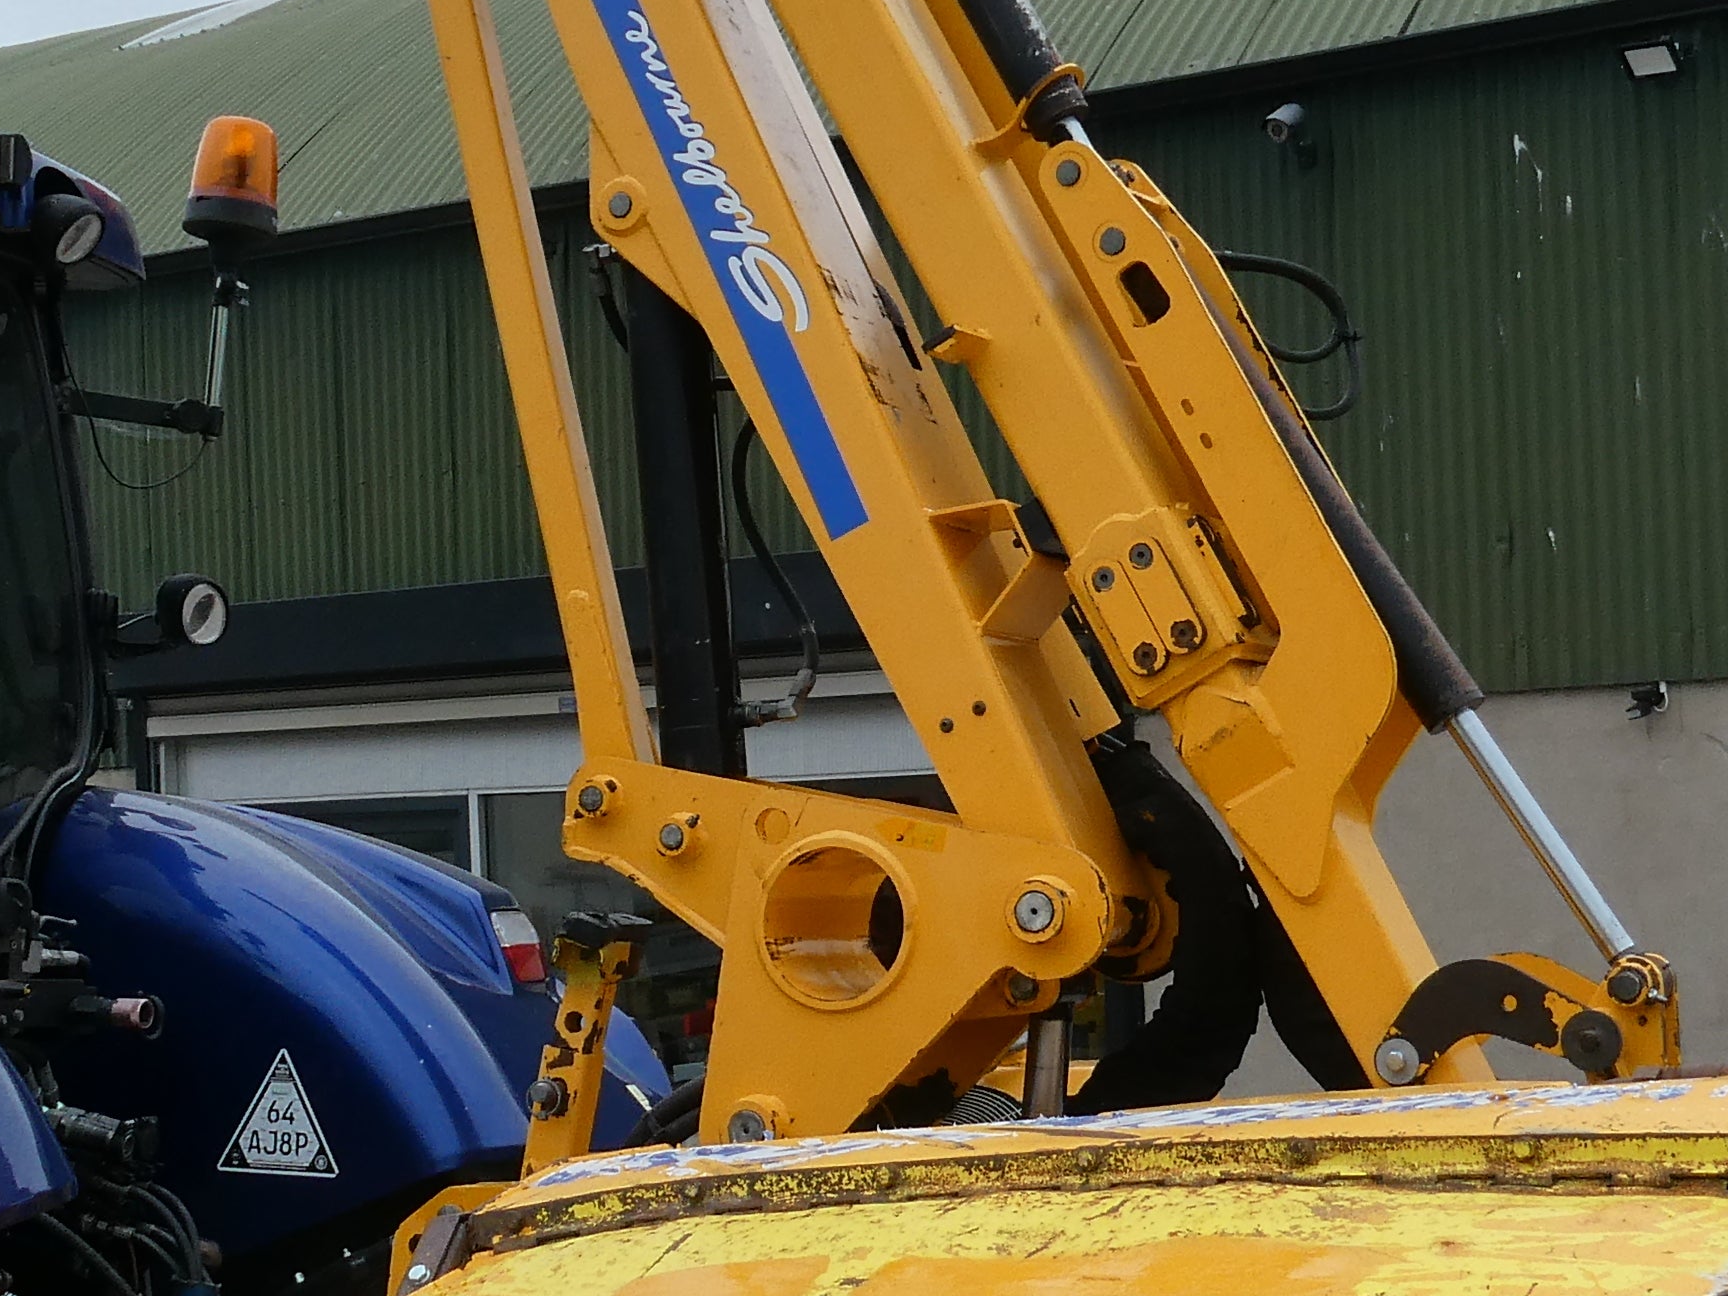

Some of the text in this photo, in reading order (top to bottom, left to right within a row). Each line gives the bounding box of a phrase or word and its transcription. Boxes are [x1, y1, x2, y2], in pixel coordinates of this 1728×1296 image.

[625, 10, 809, 332] Shelbourne
[267, 1100, 295, 1125] 64
[248, 1129, 308, 1157] AJ8P
